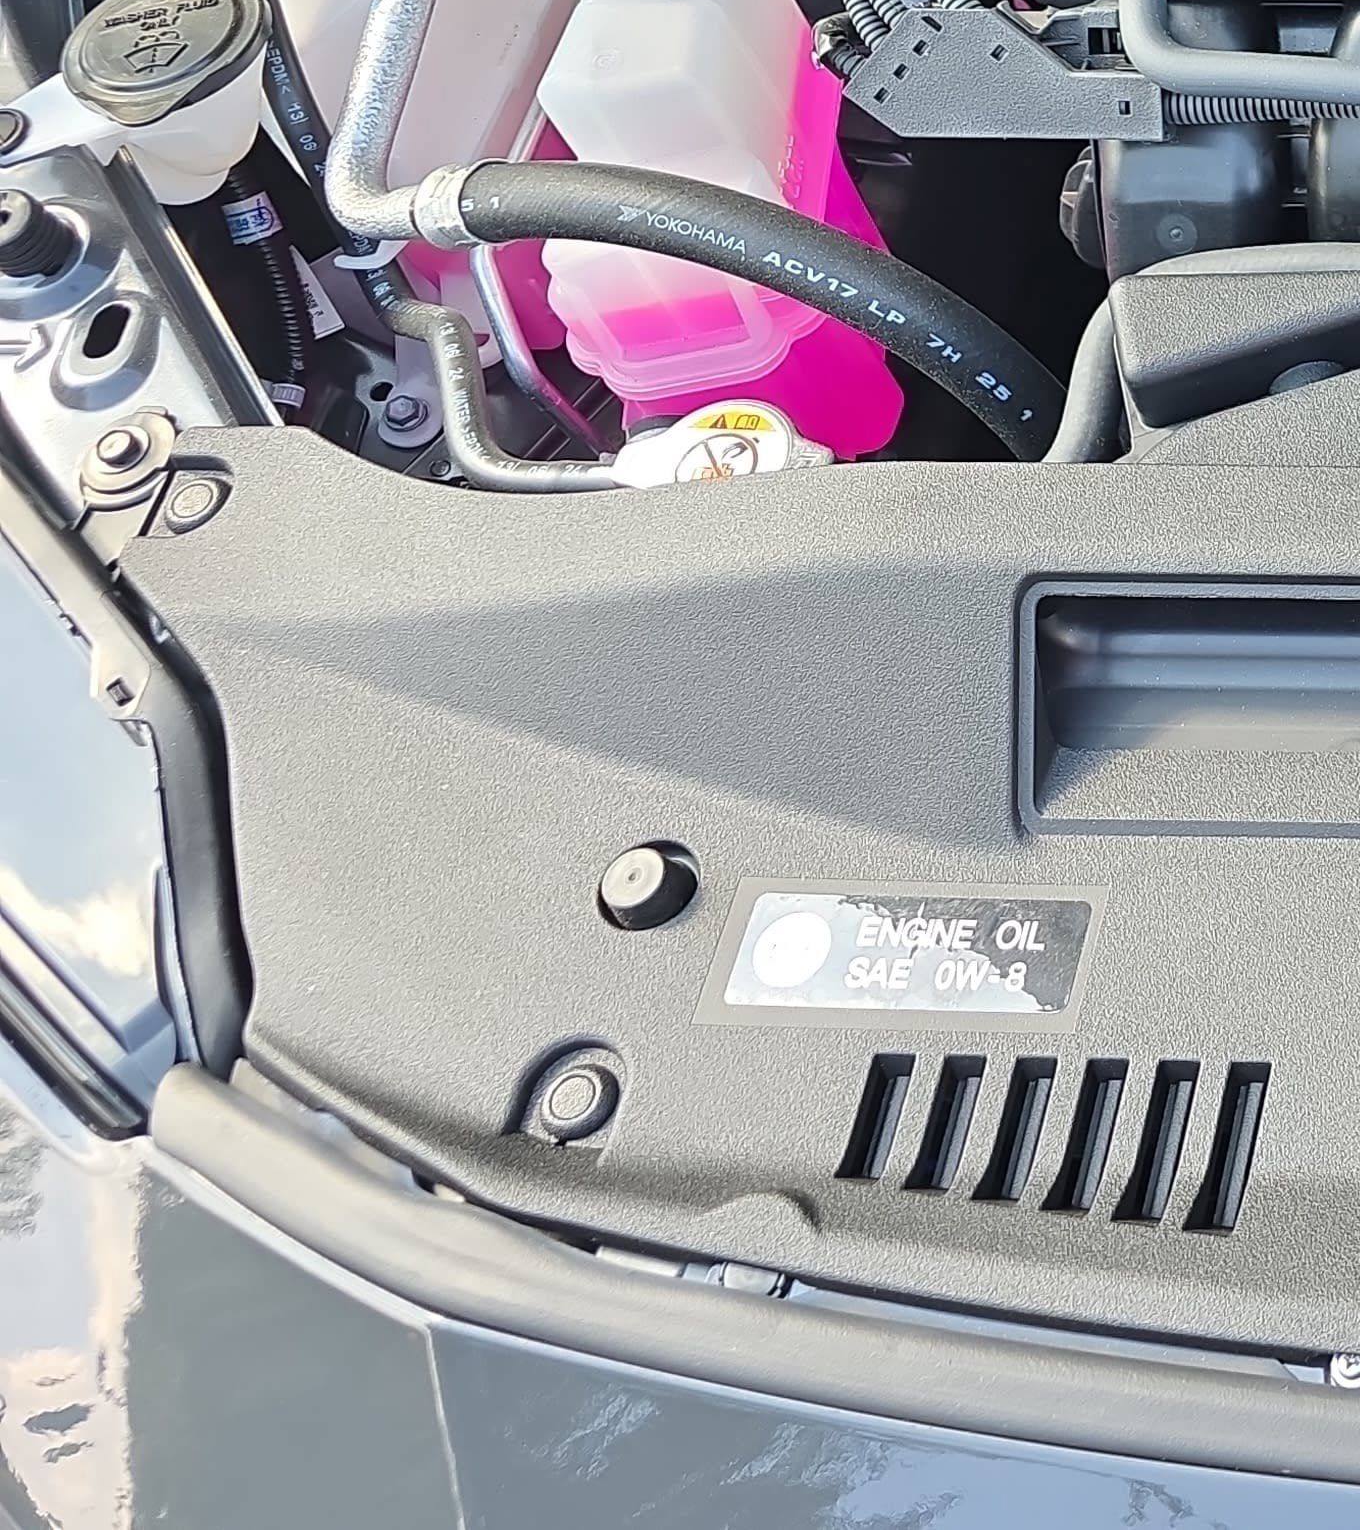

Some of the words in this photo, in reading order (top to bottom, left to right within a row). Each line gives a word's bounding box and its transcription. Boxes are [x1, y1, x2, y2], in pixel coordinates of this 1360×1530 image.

[103, 7, 168, 29] WASHER
[140, 15, 181, 32] ONLY
[646, 210, 747, 255] YOKOHAMA
[762, 249, 859, 298] ACV17
[867, 298, 907, 325] LP
[926, 332, 963, 364] 7H
[975, 370, 1013, 402] 25
[451, 386, 474, 425] WATER
[855, 916, 978, 950] ENGINE
[994, 919, 1047, 952] OIL
[843, 956, 914, 991] SAE
[933, 956, 1028, 993] 0W-8
